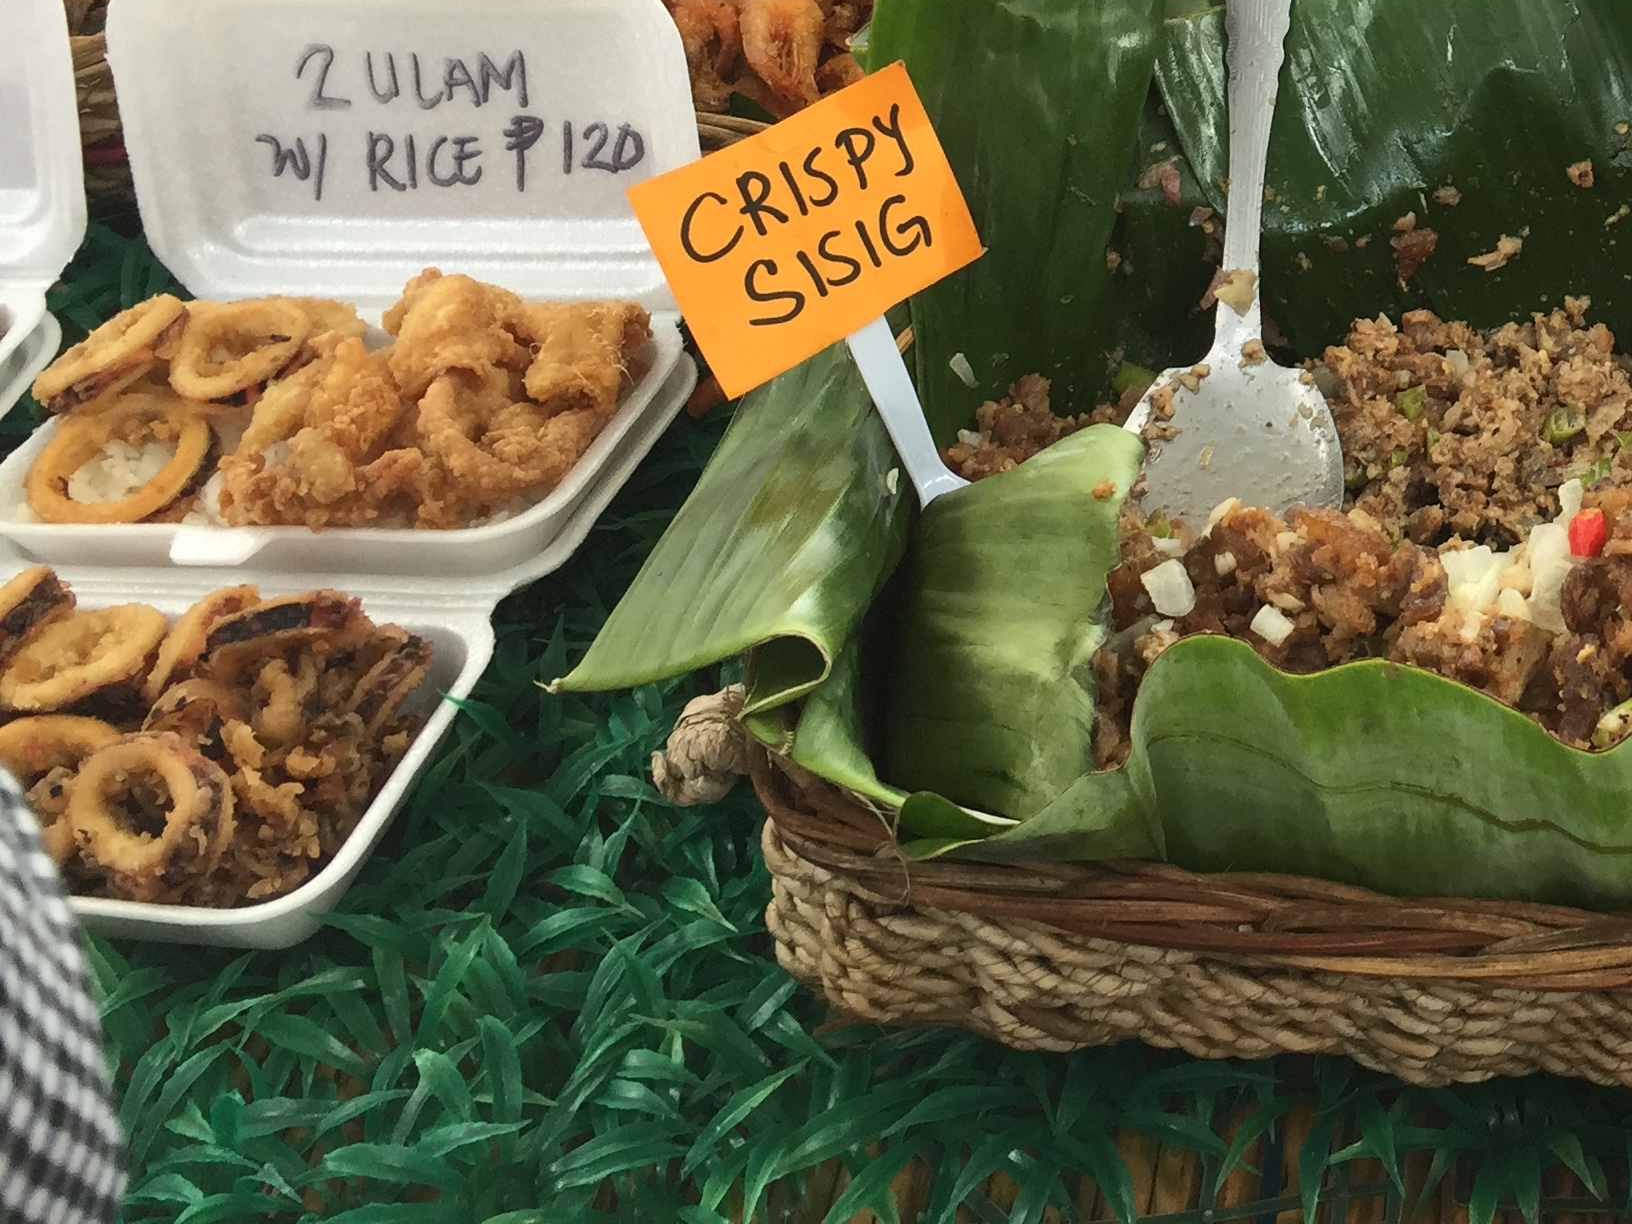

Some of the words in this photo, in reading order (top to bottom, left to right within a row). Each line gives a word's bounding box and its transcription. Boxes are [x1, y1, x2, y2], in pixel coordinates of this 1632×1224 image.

[297, 43, 352, 110] 2
[365, 48, 529, 110] ULAM
[366, 130, 483, 193] RICE
[680, 102, 915, 264] CRISPY
[744, 193, 933, 327] SISIG
